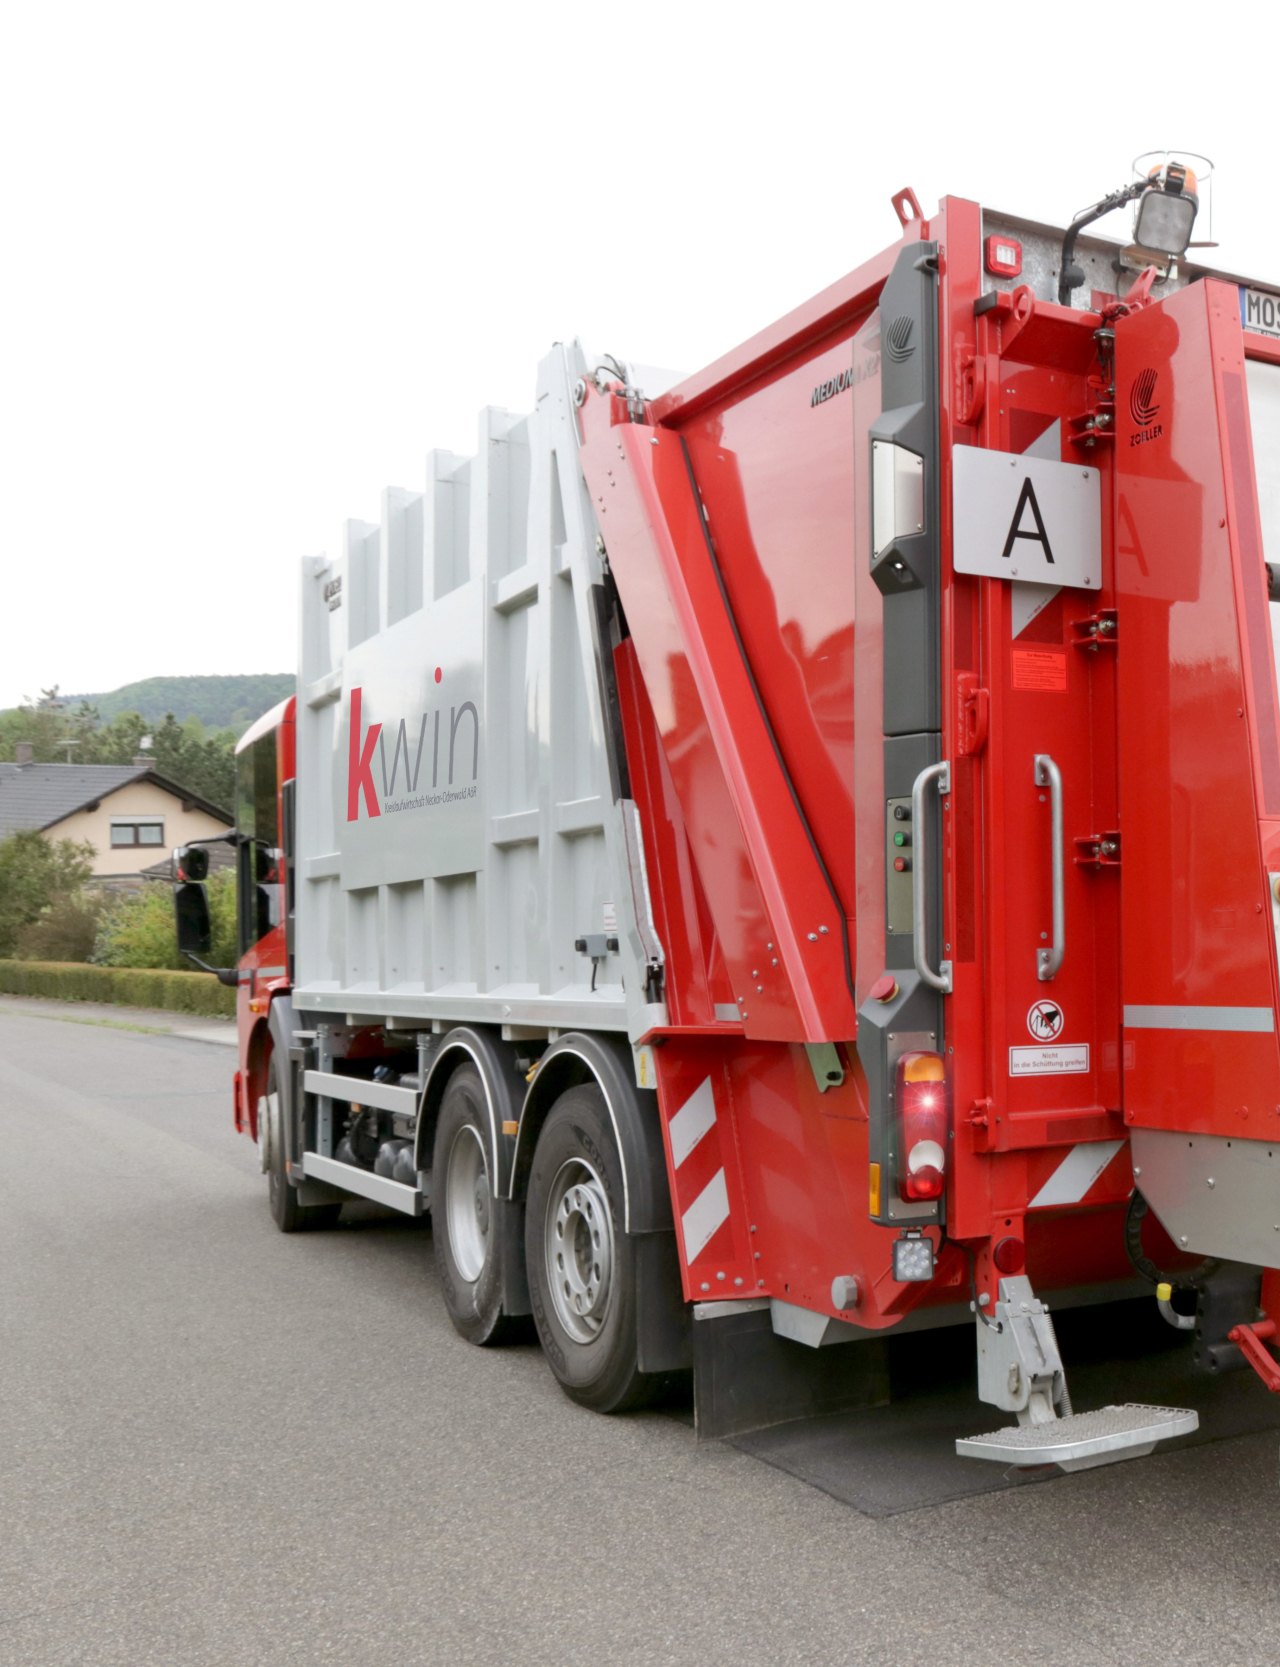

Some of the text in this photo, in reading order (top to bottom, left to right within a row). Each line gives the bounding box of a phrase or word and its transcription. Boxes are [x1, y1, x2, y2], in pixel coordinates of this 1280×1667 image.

[1130, 425, 1162, 447] ZOELLER
[1002, 477, 1055, 564] A
[347, 667, 479, 822] kwin
[1032, 1060, 1063, 1068] Schüttung
[1065, 1059, 1085, 1068] greifen
